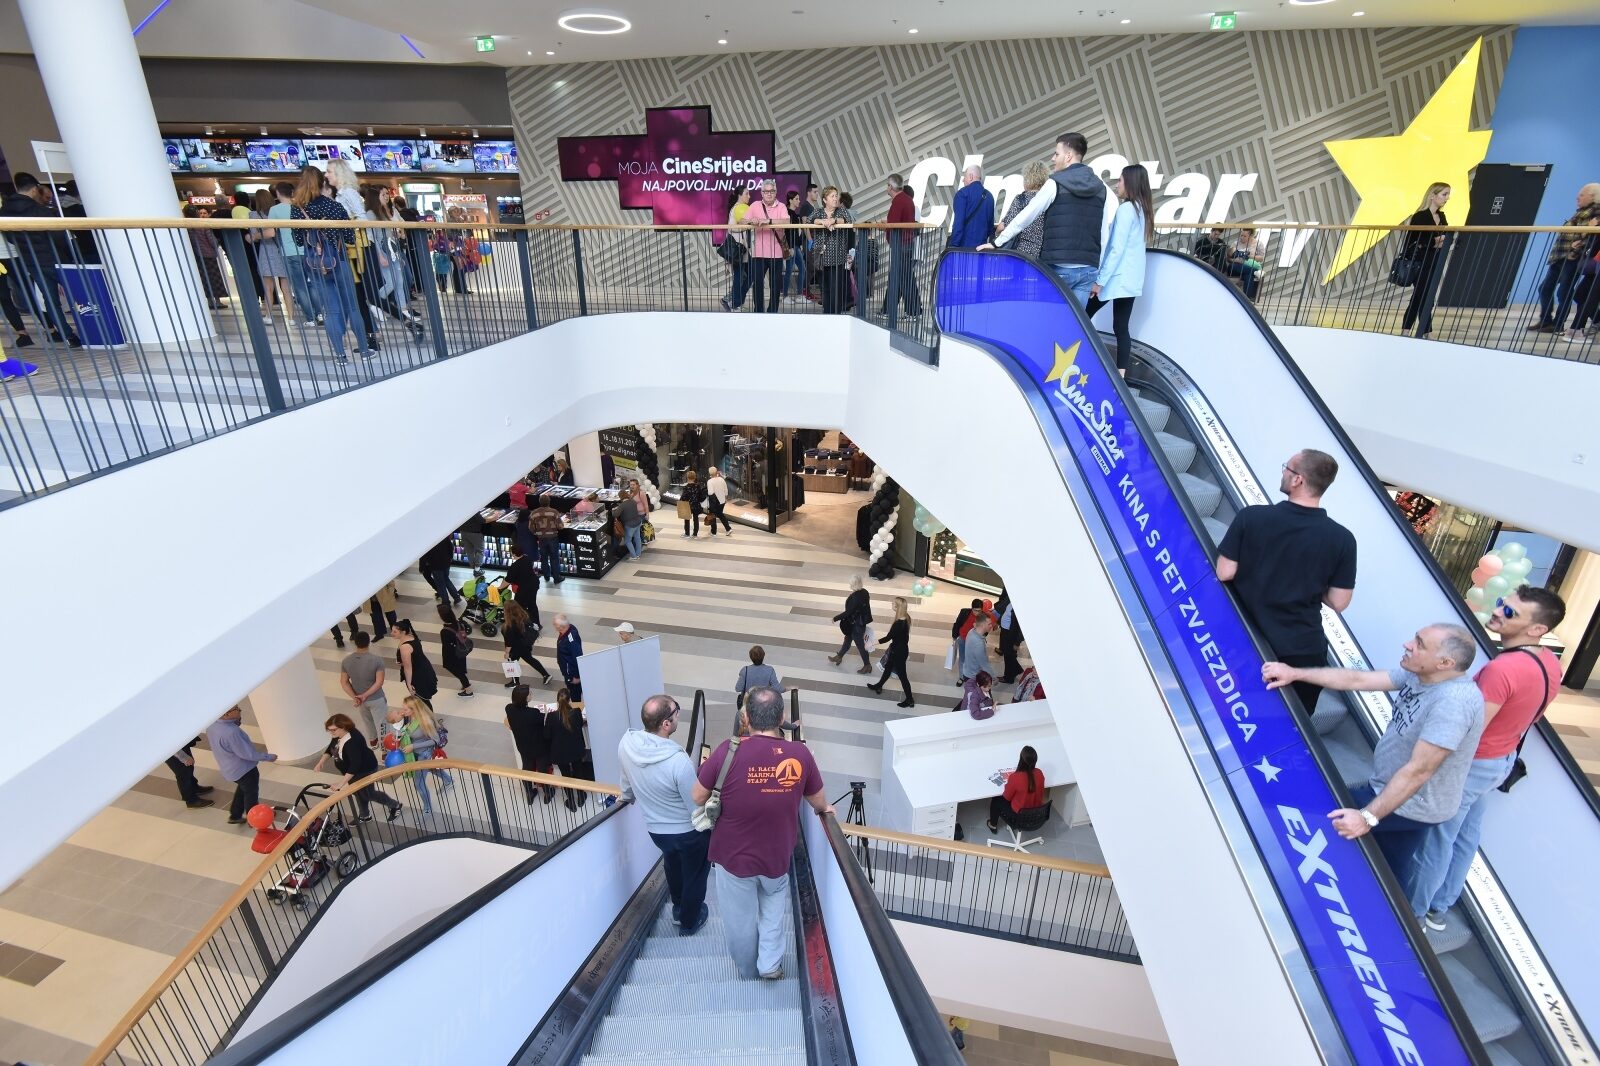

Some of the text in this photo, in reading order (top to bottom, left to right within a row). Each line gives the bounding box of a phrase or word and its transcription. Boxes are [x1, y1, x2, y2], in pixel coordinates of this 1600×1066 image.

[618, 156, 767, 176] MOJA CineSrijeda
[907, 154, 1258, 234] CinSar
[1060, 364, 1125, 461] CineStar
[1118, 473, 1257, 743] KINA S PET ZVJEZDICA
[1277, 804, 1424, 1066] EXTREME
[1543, 992, 1585, 1053] EXTREME
